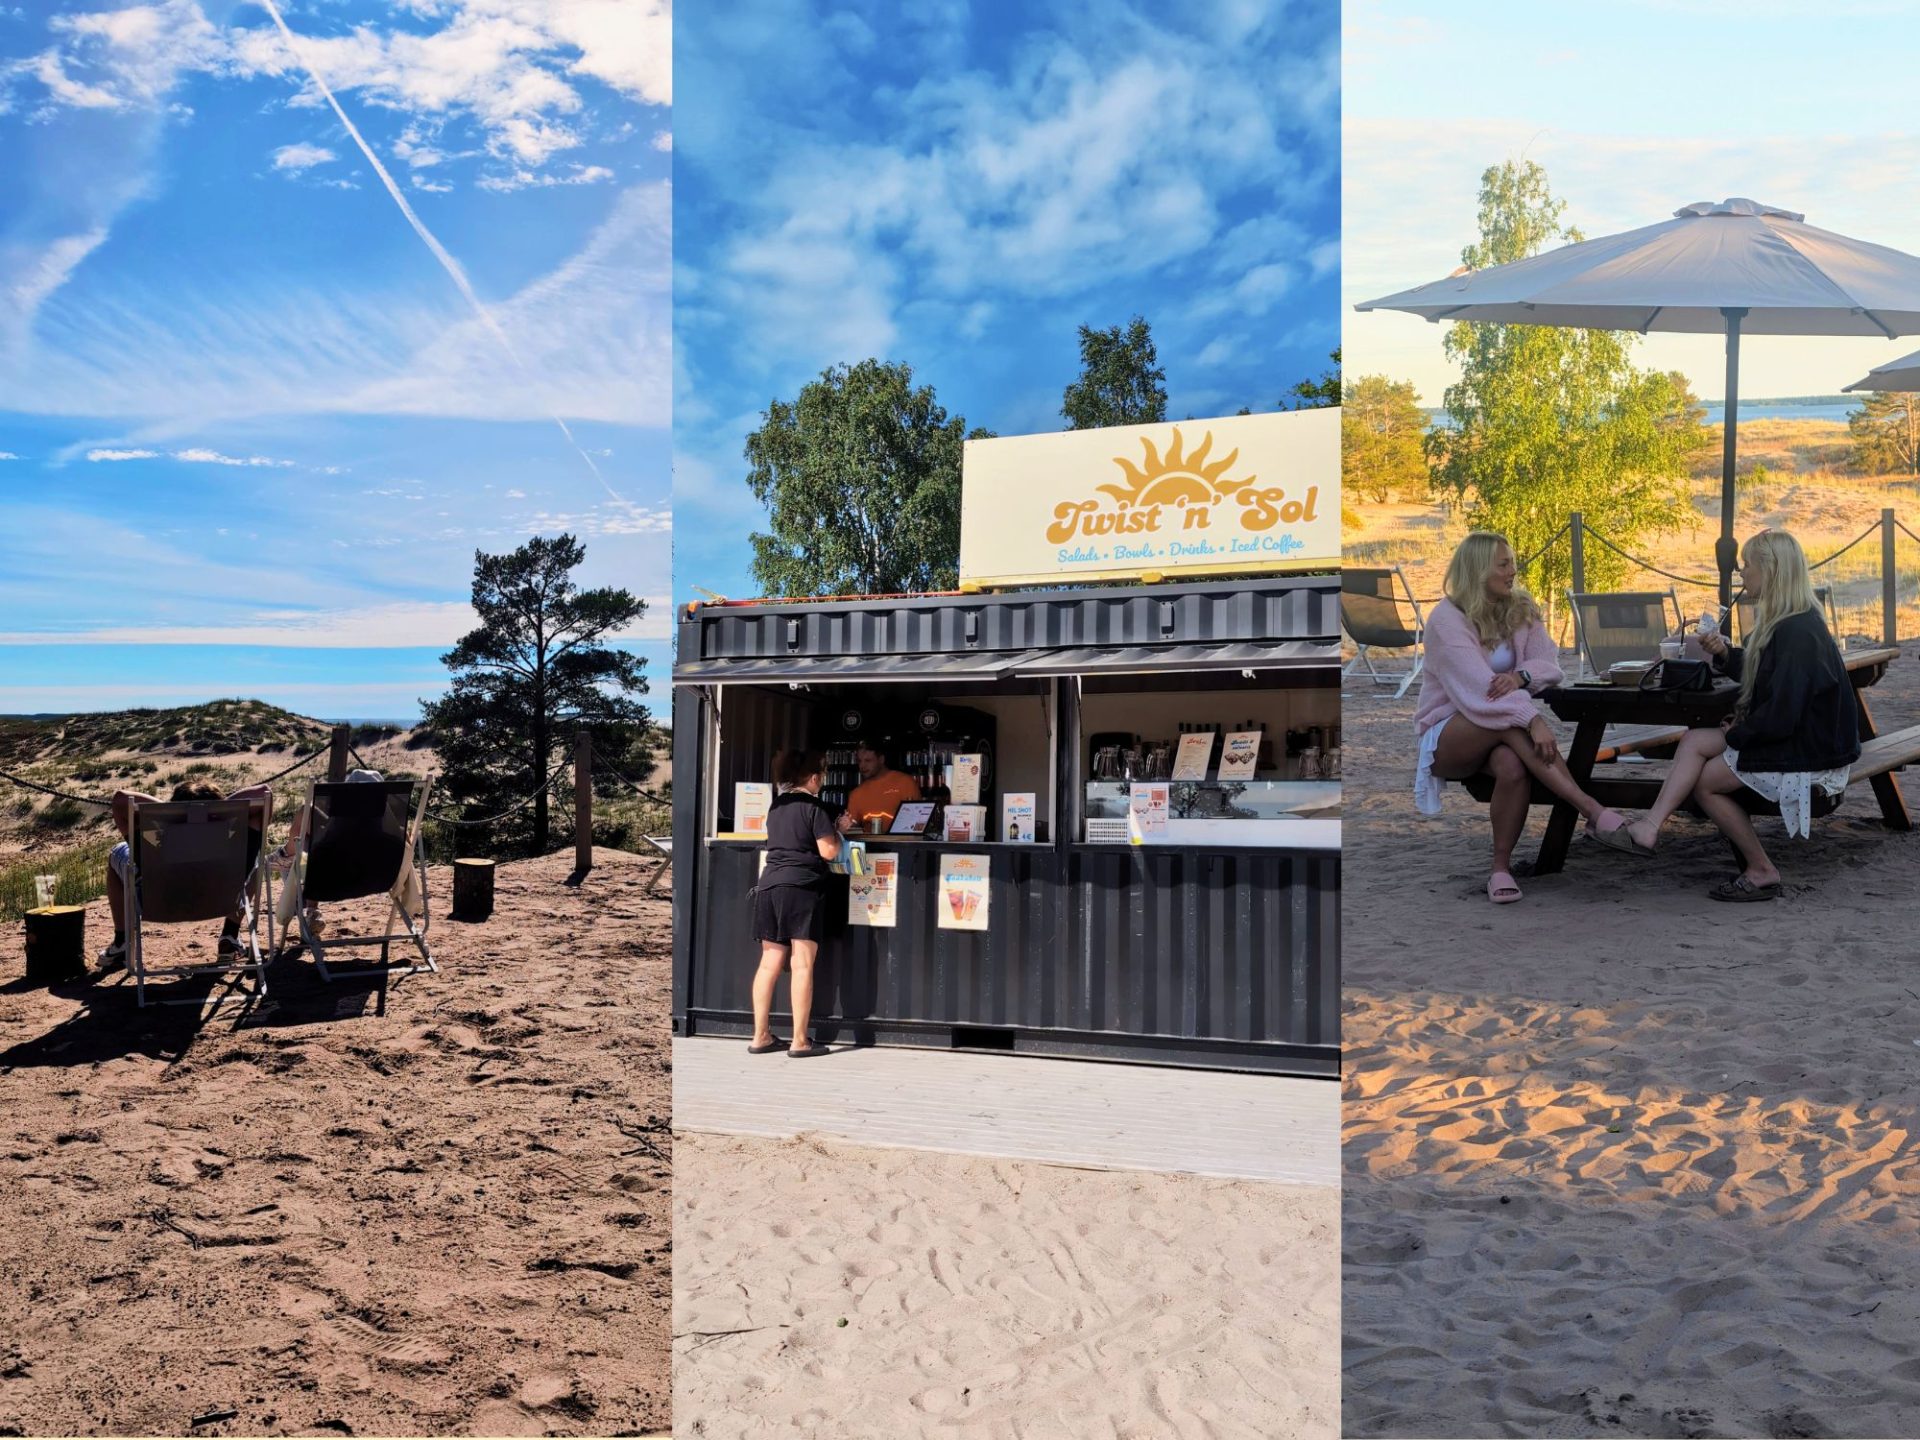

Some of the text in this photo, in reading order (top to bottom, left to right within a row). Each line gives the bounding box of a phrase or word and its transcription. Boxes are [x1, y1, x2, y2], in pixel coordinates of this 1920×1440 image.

[1046, 500, 1162, 544] Twist
[1236, 486, 1318, 531] Sol
[1058, 534, 1304, 562] Salads Bowls Drinks Iced Coffee
